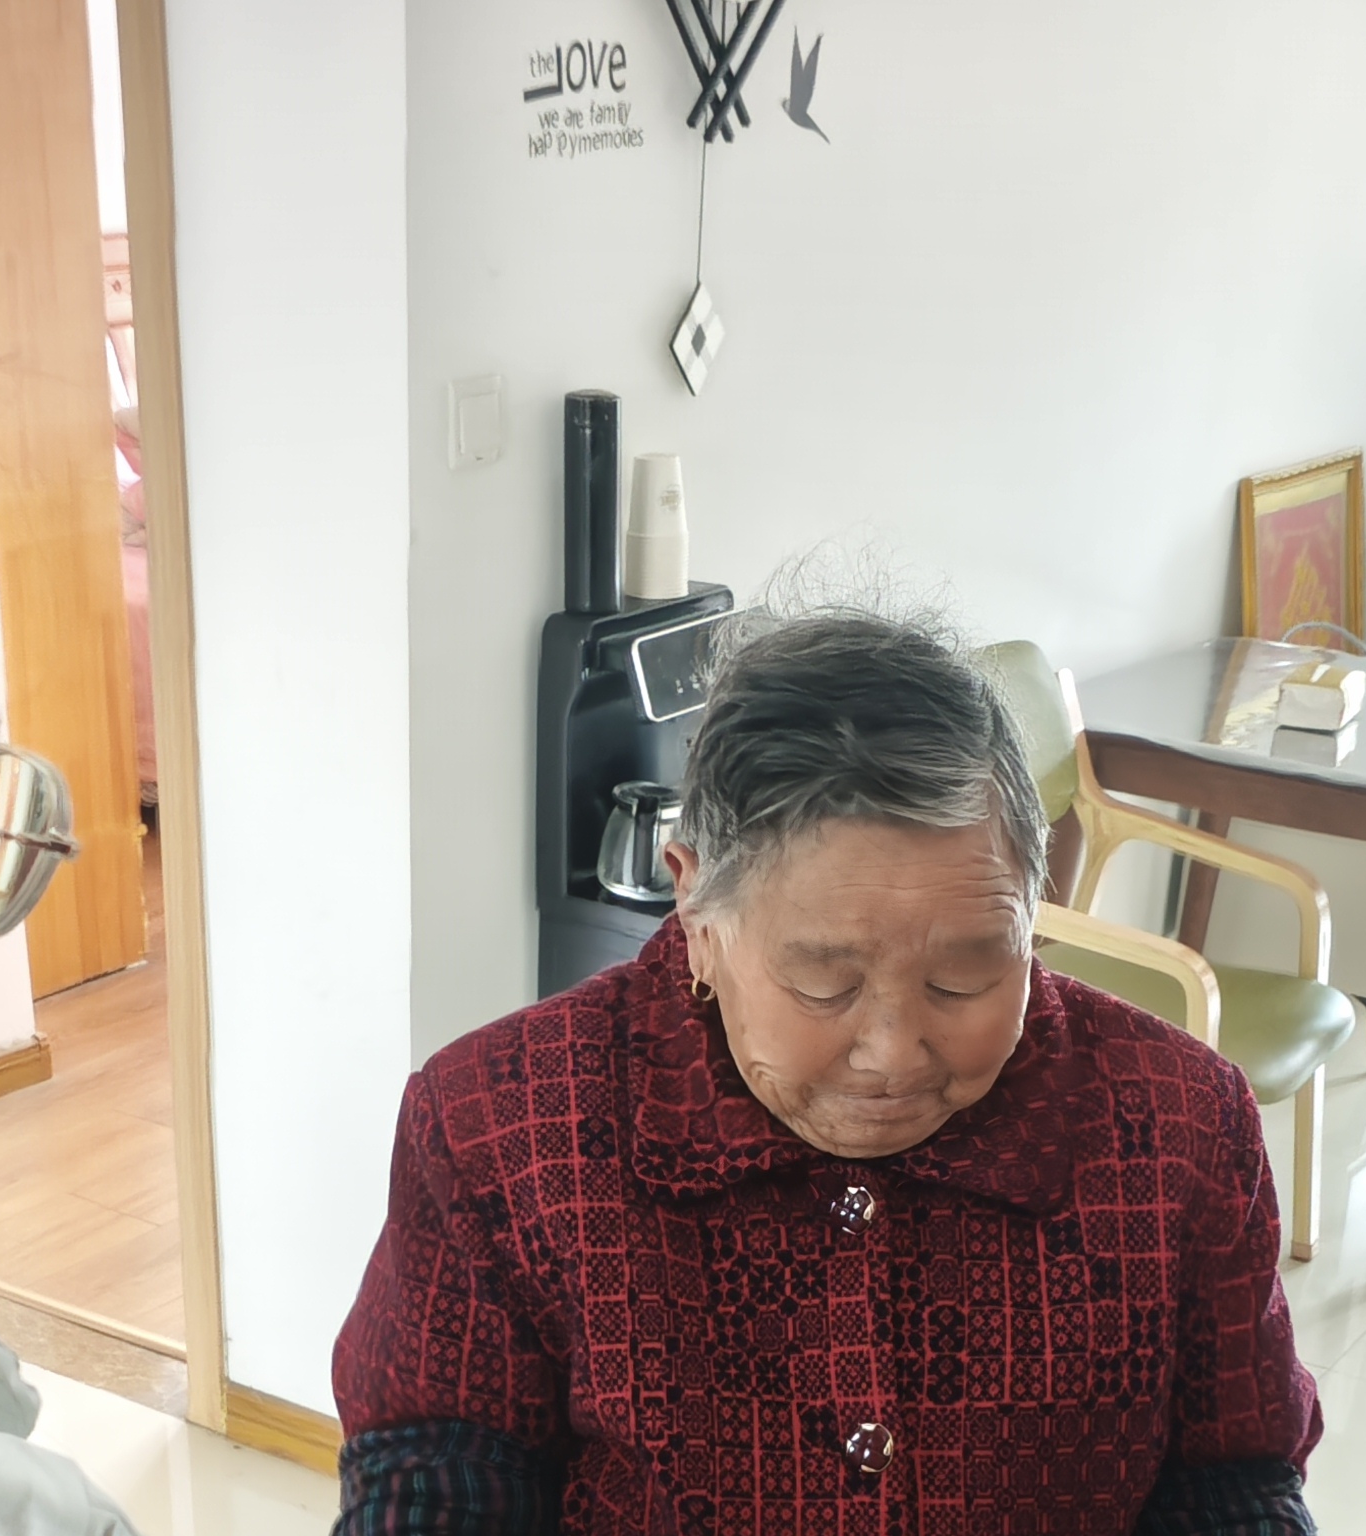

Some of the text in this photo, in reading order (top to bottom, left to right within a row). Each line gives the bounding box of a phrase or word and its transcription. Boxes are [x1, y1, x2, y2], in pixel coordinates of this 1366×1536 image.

[530, 49, 555, 78] the
[539, 110, 560, 129] we
[564, 108, 584, 129] are
